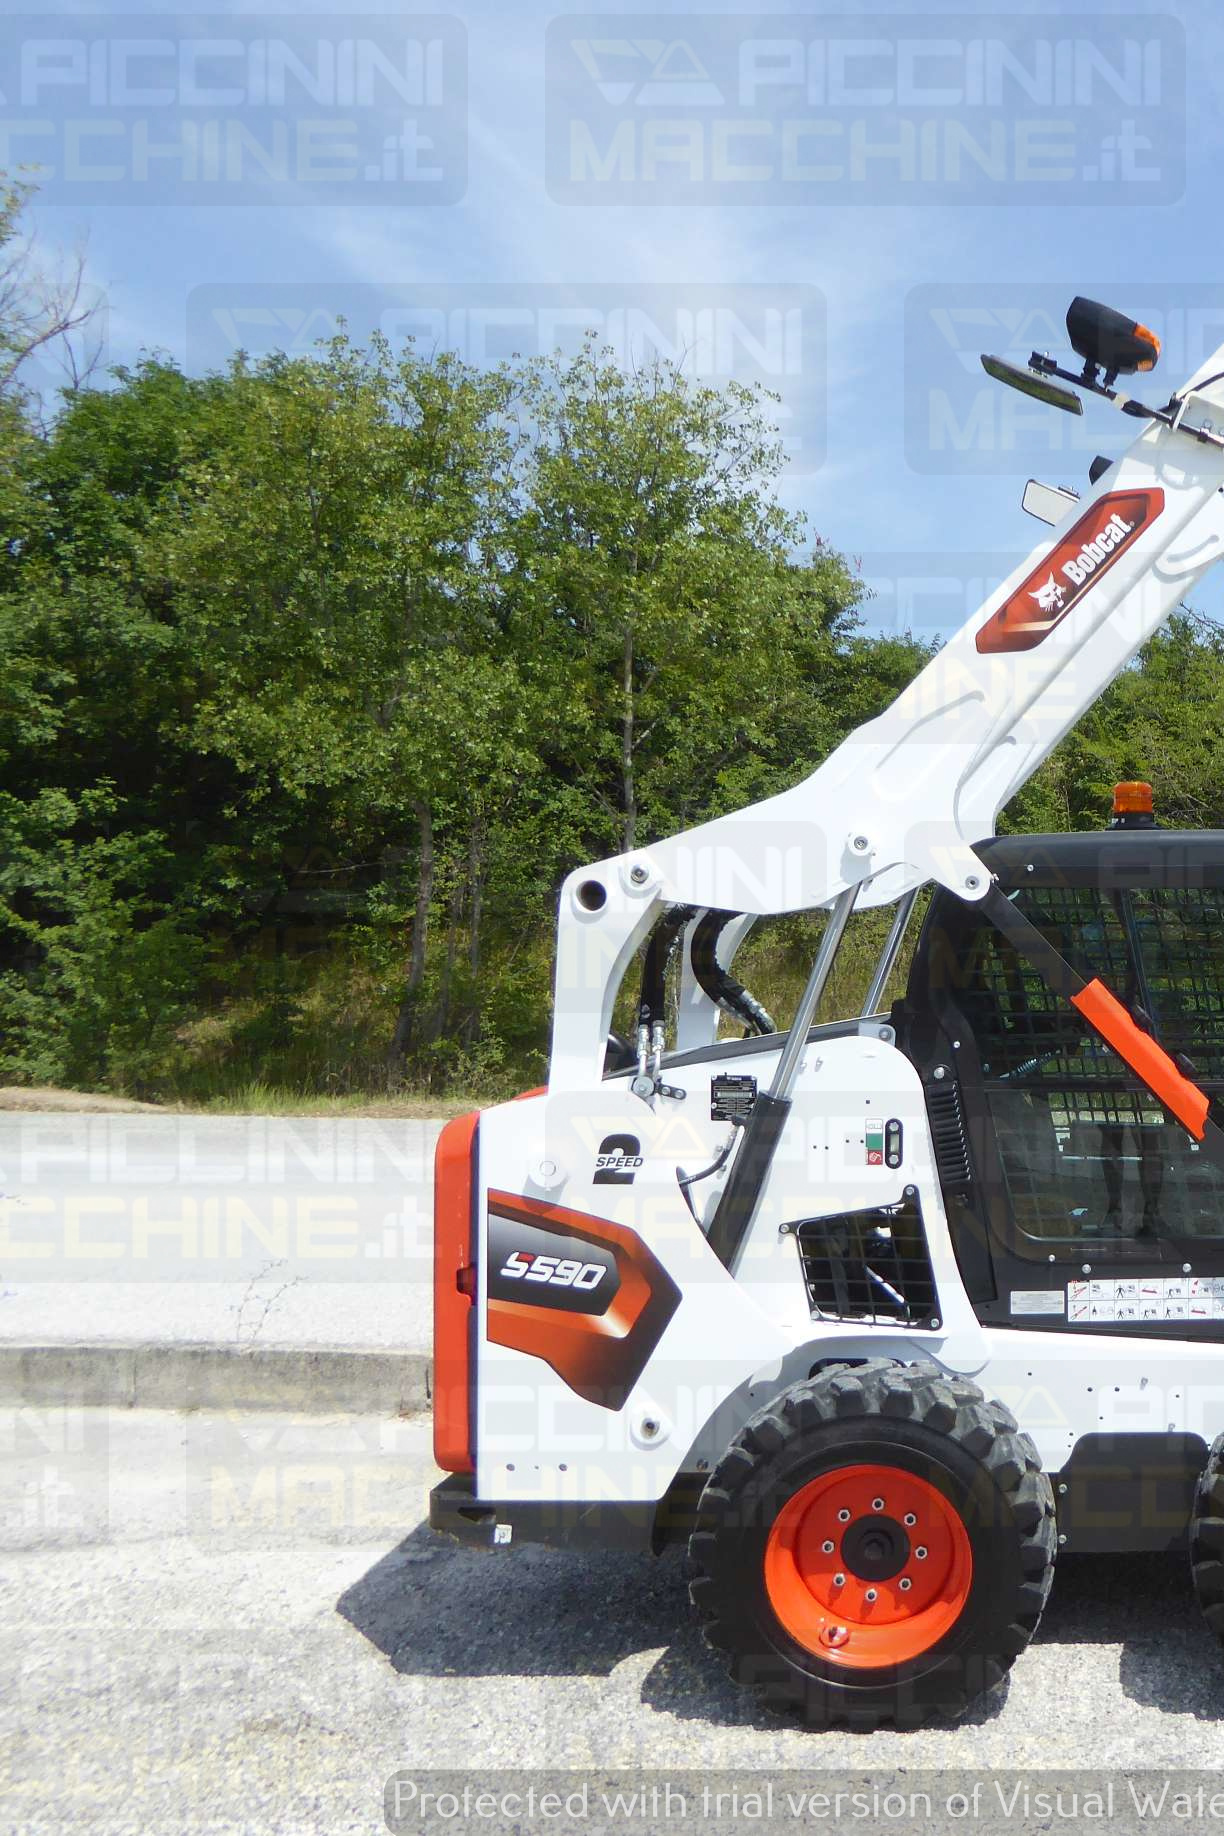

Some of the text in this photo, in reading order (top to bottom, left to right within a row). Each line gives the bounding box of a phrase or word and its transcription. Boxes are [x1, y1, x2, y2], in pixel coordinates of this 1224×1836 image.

[1061, 513, 1132, 586] Bobcat
[592, 1133, 641, 1185] 2
[596, 1156, 644, 1168] SPEED
[500, 1251, 607, 1290] S590
